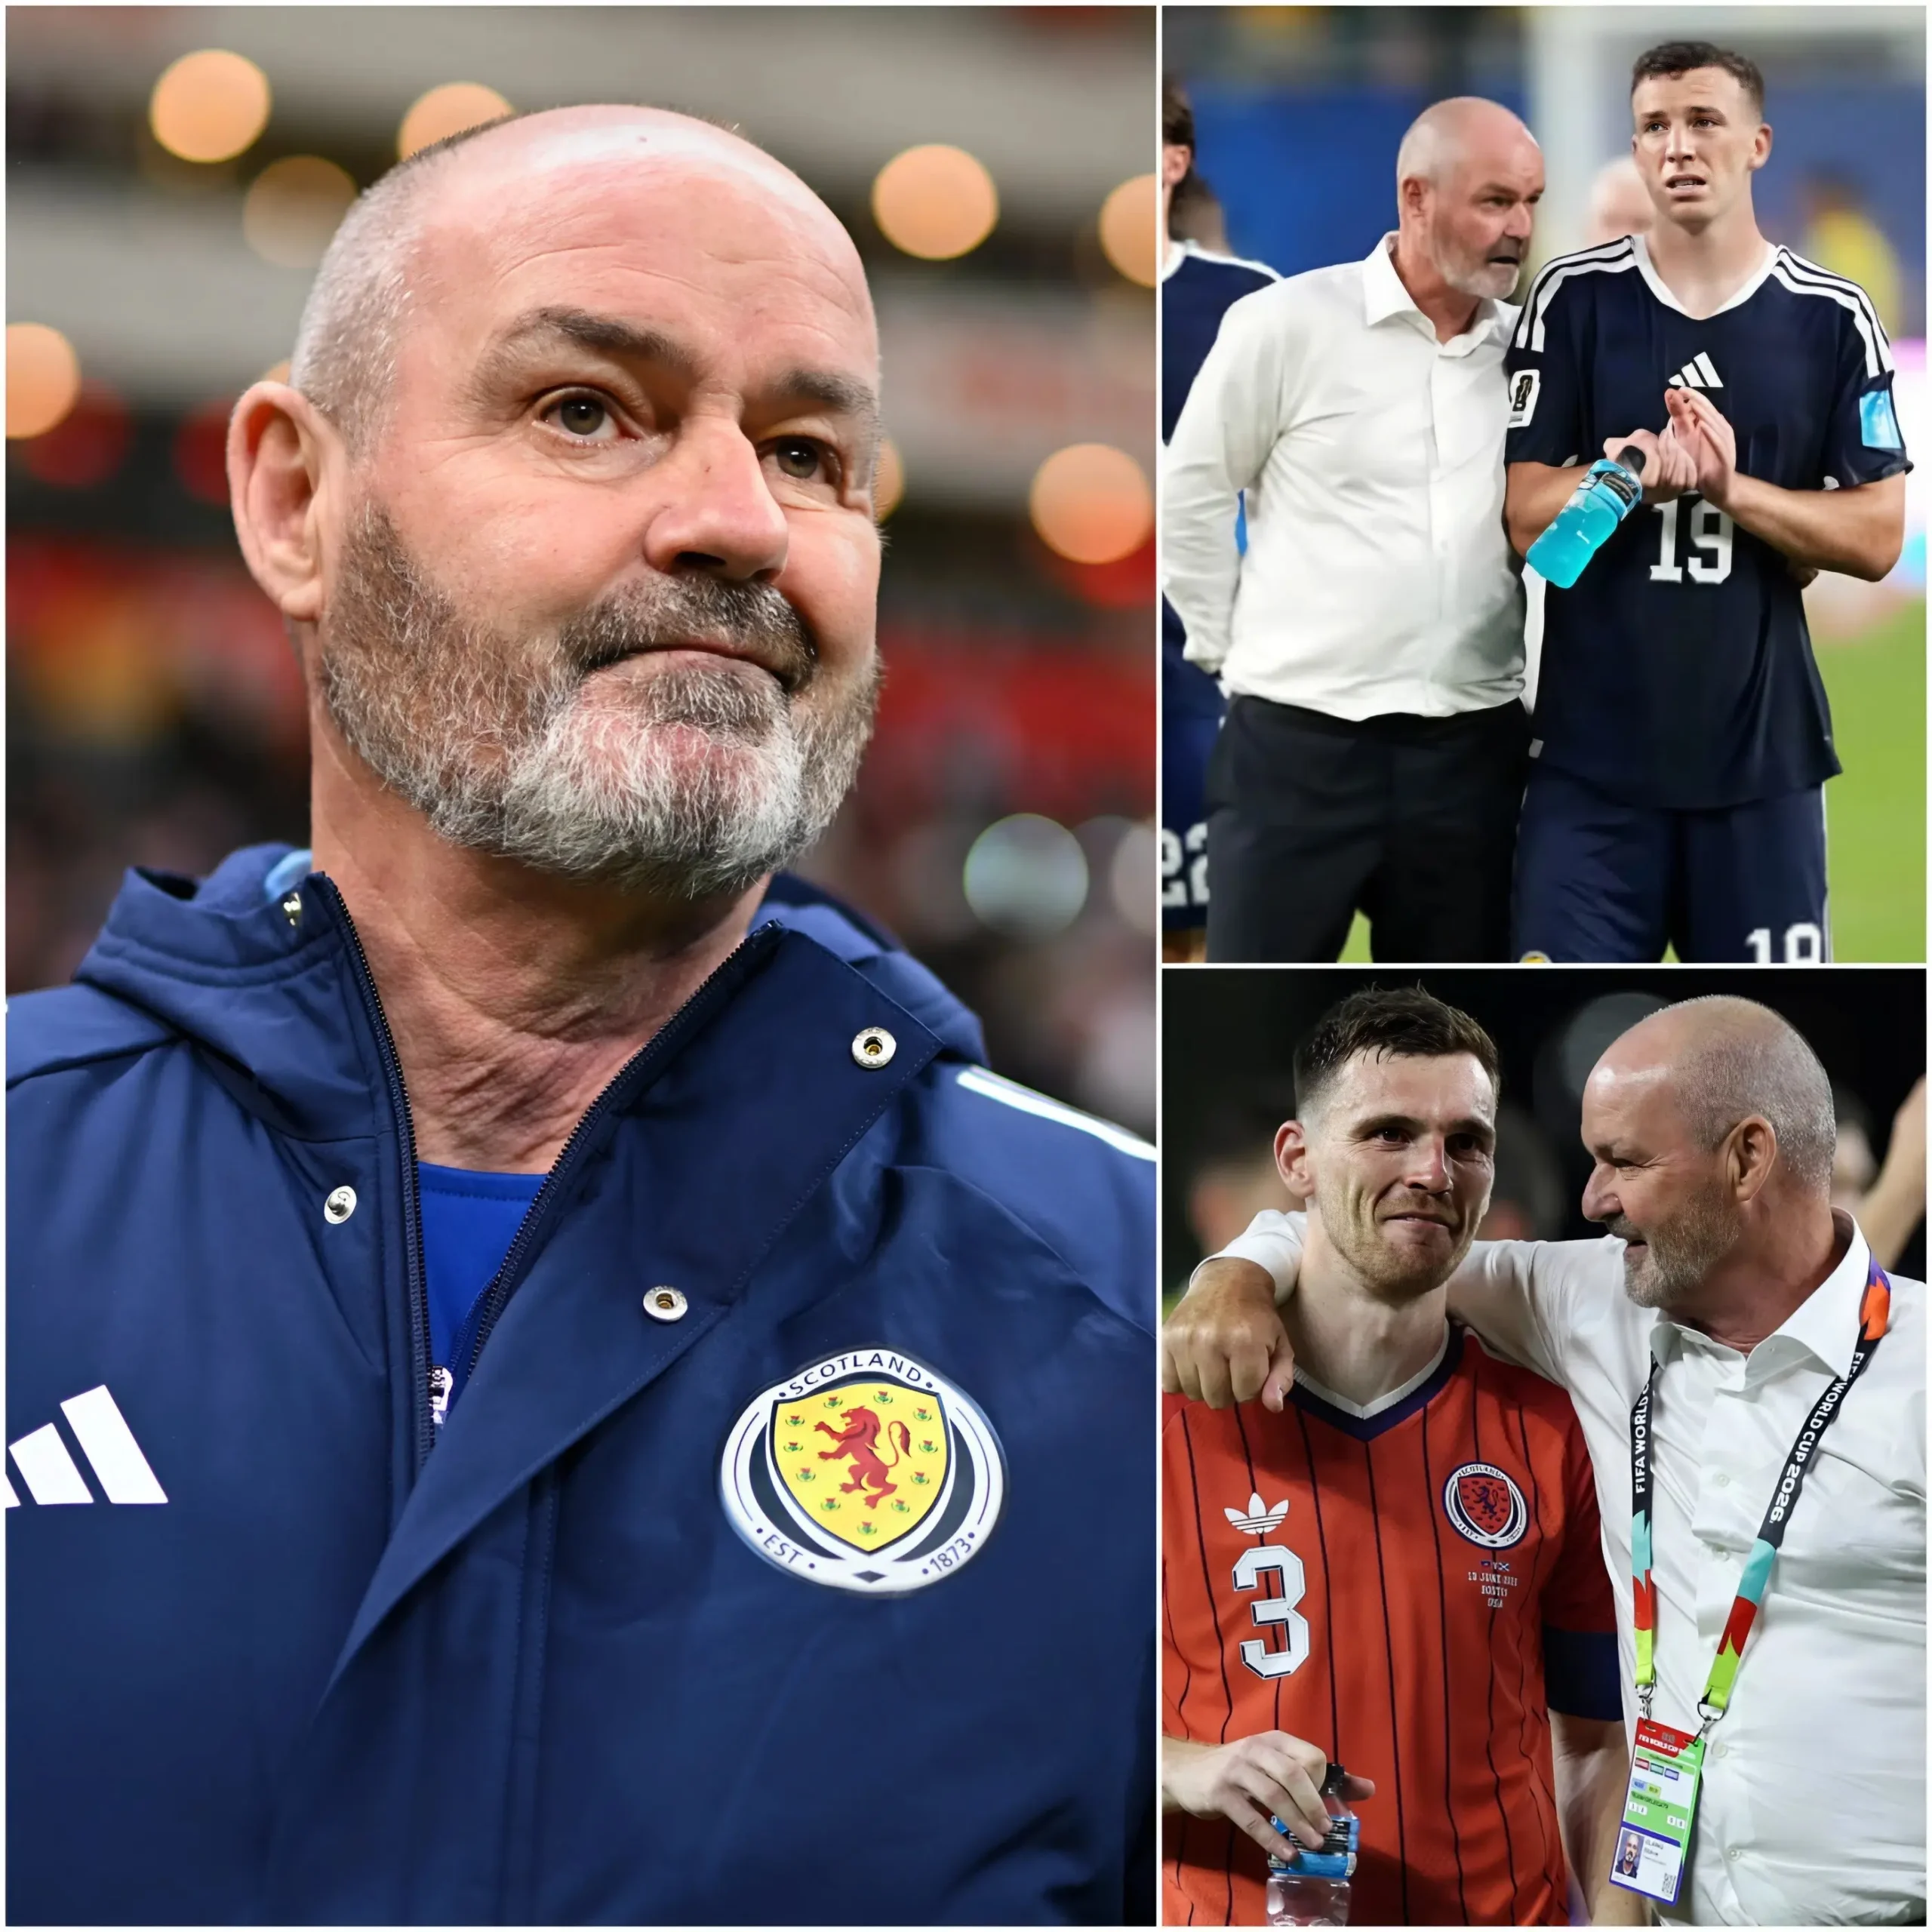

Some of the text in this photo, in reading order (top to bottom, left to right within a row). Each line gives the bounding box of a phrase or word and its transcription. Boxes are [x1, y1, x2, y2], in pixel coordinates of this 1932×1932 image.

[1650, 491, 1734, 584] 19
[789, 1352, 922, 1395] SCOTLAND
[1634, 1396, 1649, 1455] WORLD
[1810, 1382, 1848, 1429] WORLD
[1795, 1431, 1816, 1463] CUP
[1635, 1456, 1646, 1494] FIFA
[762, 1534, 803, 1564] EST
[929, 1538, 973, 1572] 1873
[1232, 1545, 1309, 1680] 3
